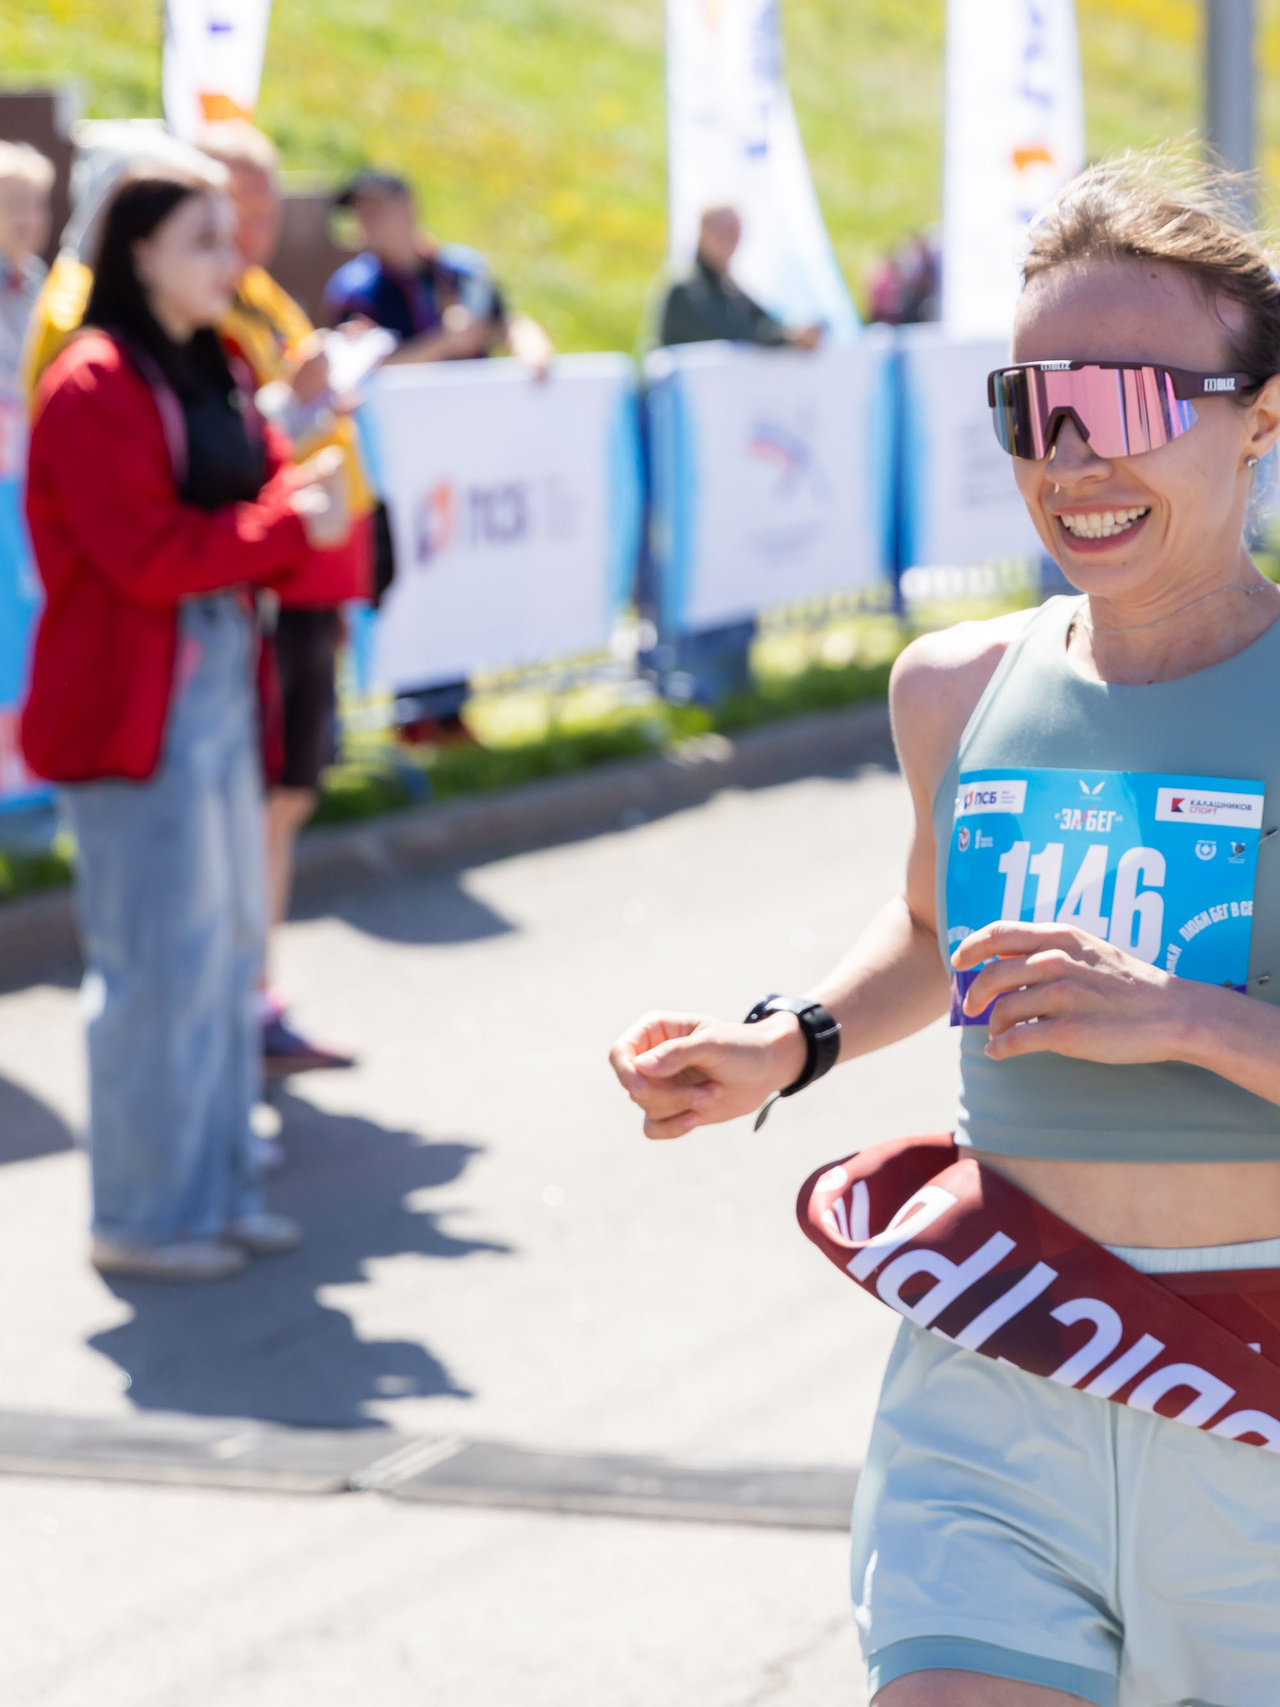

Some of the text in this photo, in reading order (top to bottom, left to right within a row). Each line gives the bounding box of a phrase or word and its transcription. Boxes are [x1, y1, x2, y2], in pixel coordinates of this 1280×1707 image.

[975, 791, 997, 805] ПСБ
[1189, 806, 1217, 815] СПОРТ
[1190, 800, 1252, 811] КАЛАШНИКОВ
[998, 841, 1167, 965] 1146
[1208, 903, 1229, 923] БЕГ
[1230, 901, 1239, 917] В
